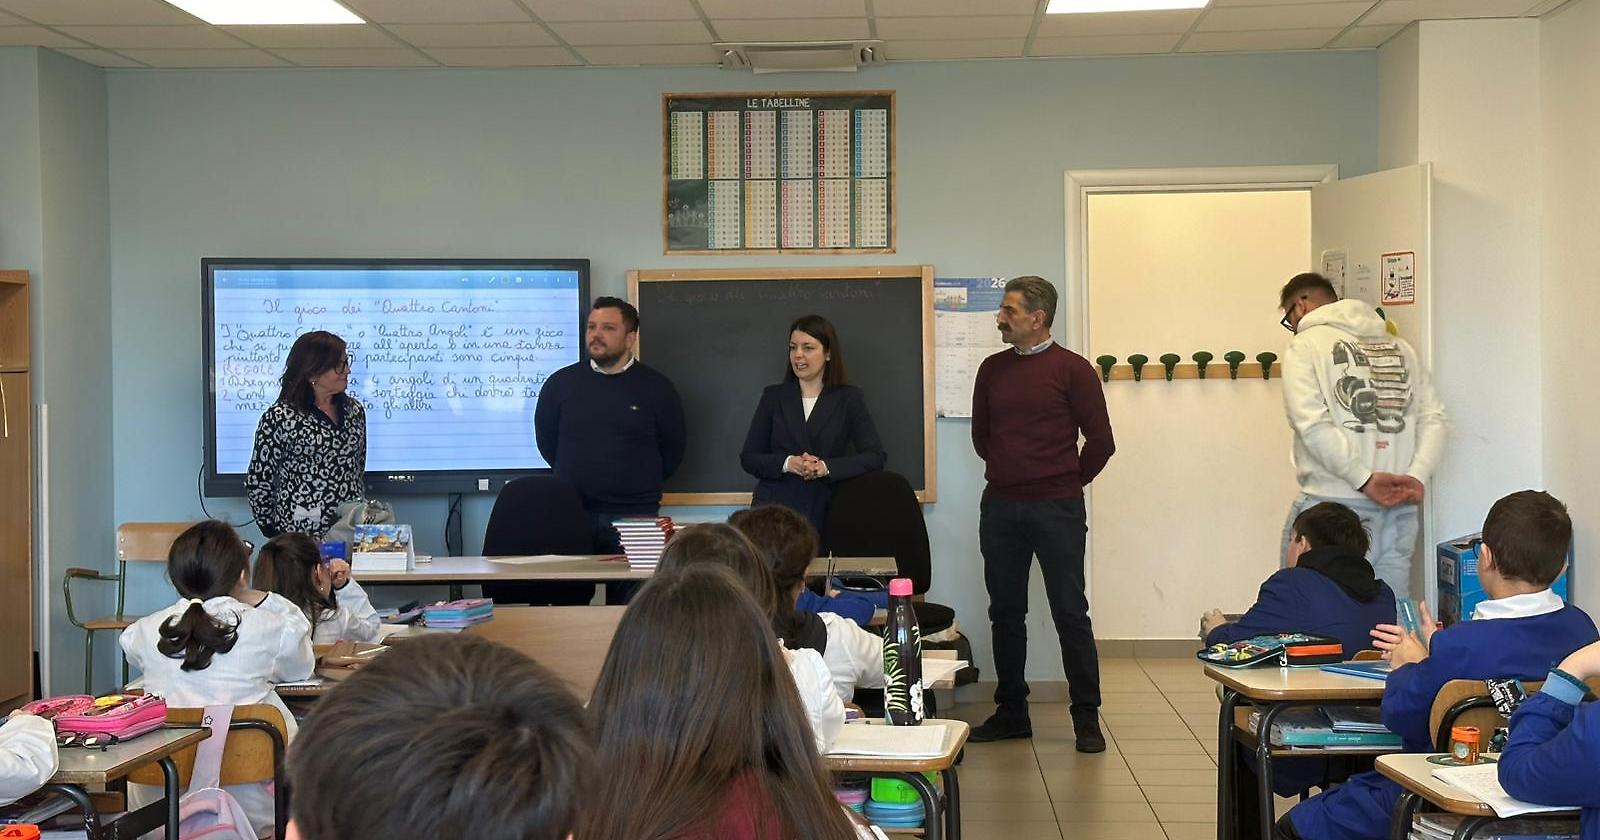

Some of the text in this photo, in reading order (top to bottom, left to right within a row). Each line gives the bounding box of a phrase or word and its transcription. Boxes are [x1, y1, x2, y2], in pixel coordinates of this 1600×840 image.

[746, 97, 811, 109] LE TABELLINE
[976, 277, 1006, 289] 2026
[263, 298, 283, 314] Il
[294, 302, 327, 325] gioco
[342, 298, 361, 314] dei
[358, 330, 365, 339] o
[504, 327, 528, 337] un
[535, 327, 565, 339] gioco
[223, 340, 245, 352] che
[253, 342, 267, 352] si
[463, 341, 480, 350] in
[484, 341, 511, 350] una
[365, 351, 444, 371] partecipanti
[452, 353, 483, 362] sono
[490, 351, 535, 370] cinque
[222, 362, 275, 377] REGOLE
[389, 370, 435, 391] angoli
[463, 375, 482, 385] un
[446, 384, 468, 398] chi
